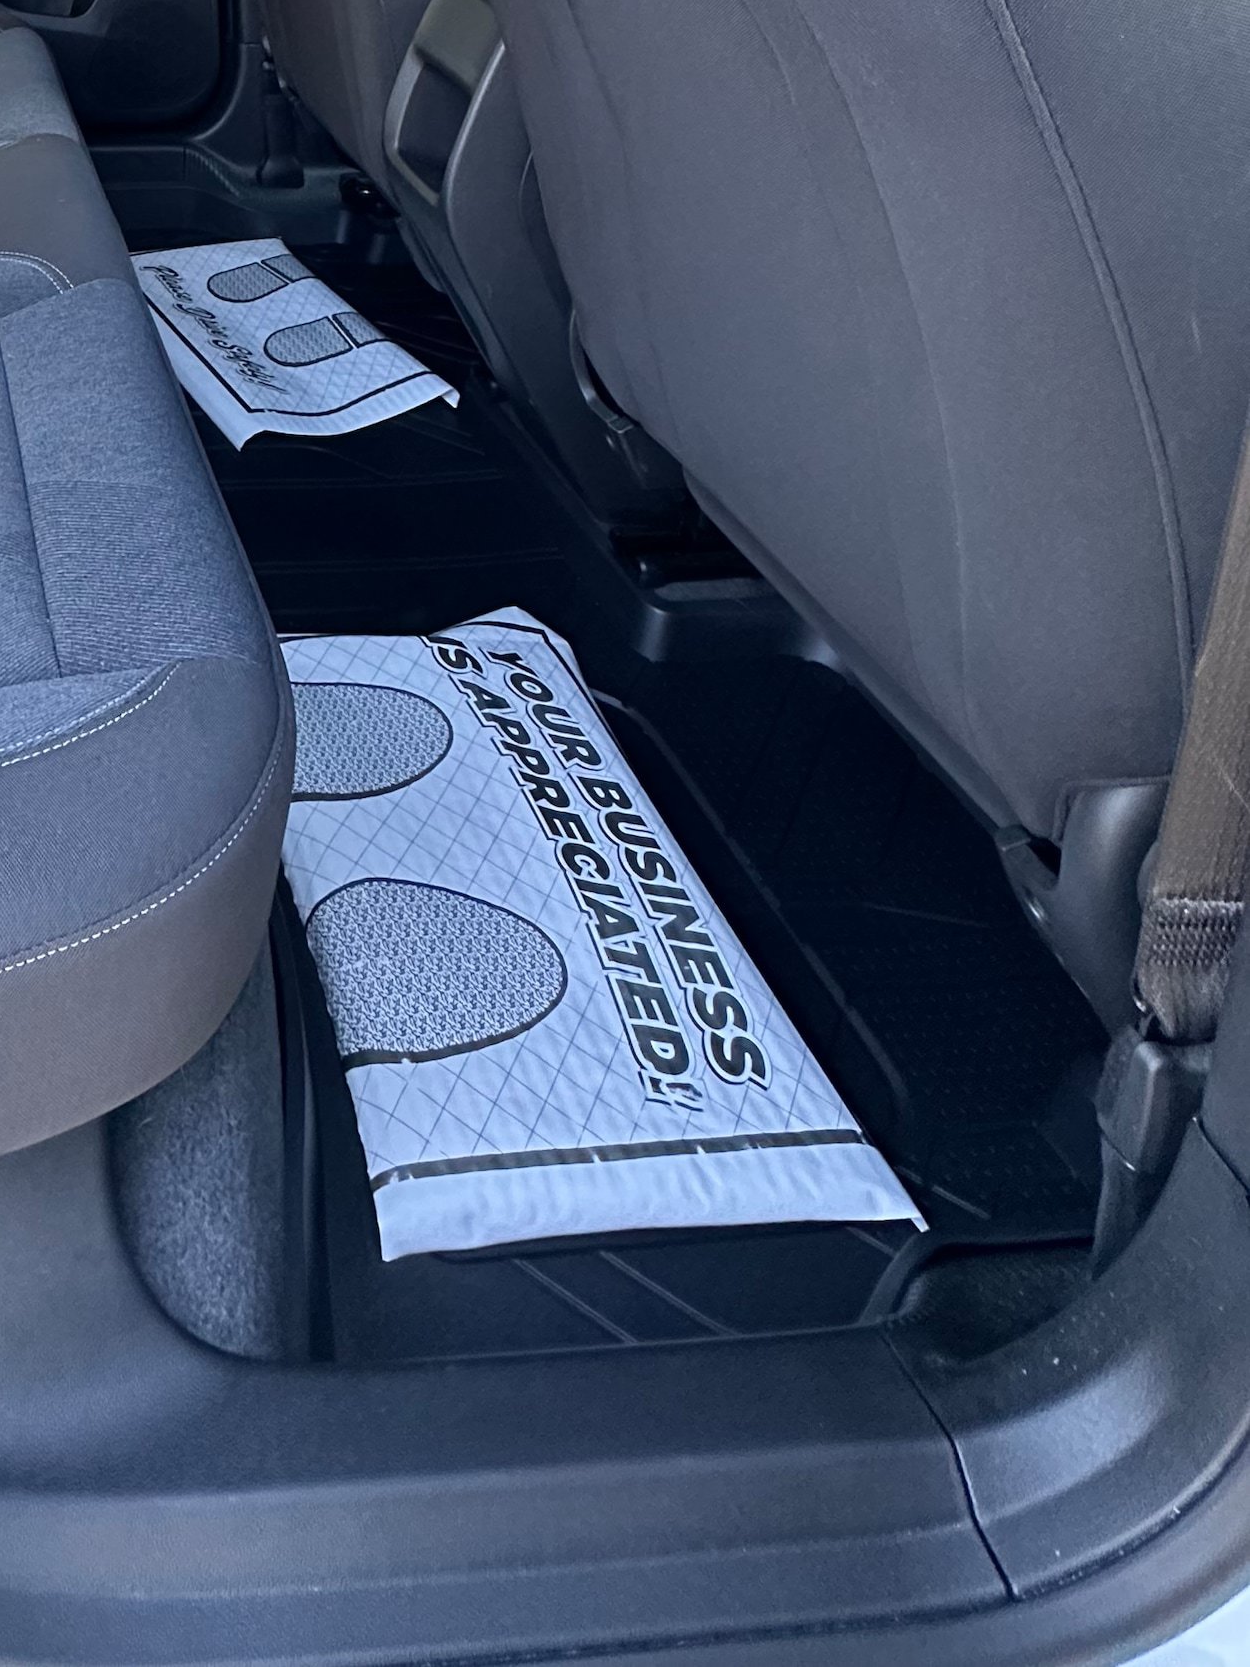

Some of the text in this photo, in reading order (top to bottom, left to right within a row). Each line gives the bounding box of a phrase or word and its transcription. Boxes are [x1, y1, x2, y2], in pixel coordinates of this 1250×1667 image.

[139, 265, 193, 303] Please
[422, 635, 706, 1108] IS APPRECIATED!
[482, 646, 770, 1089] YOUR BUSINESS
